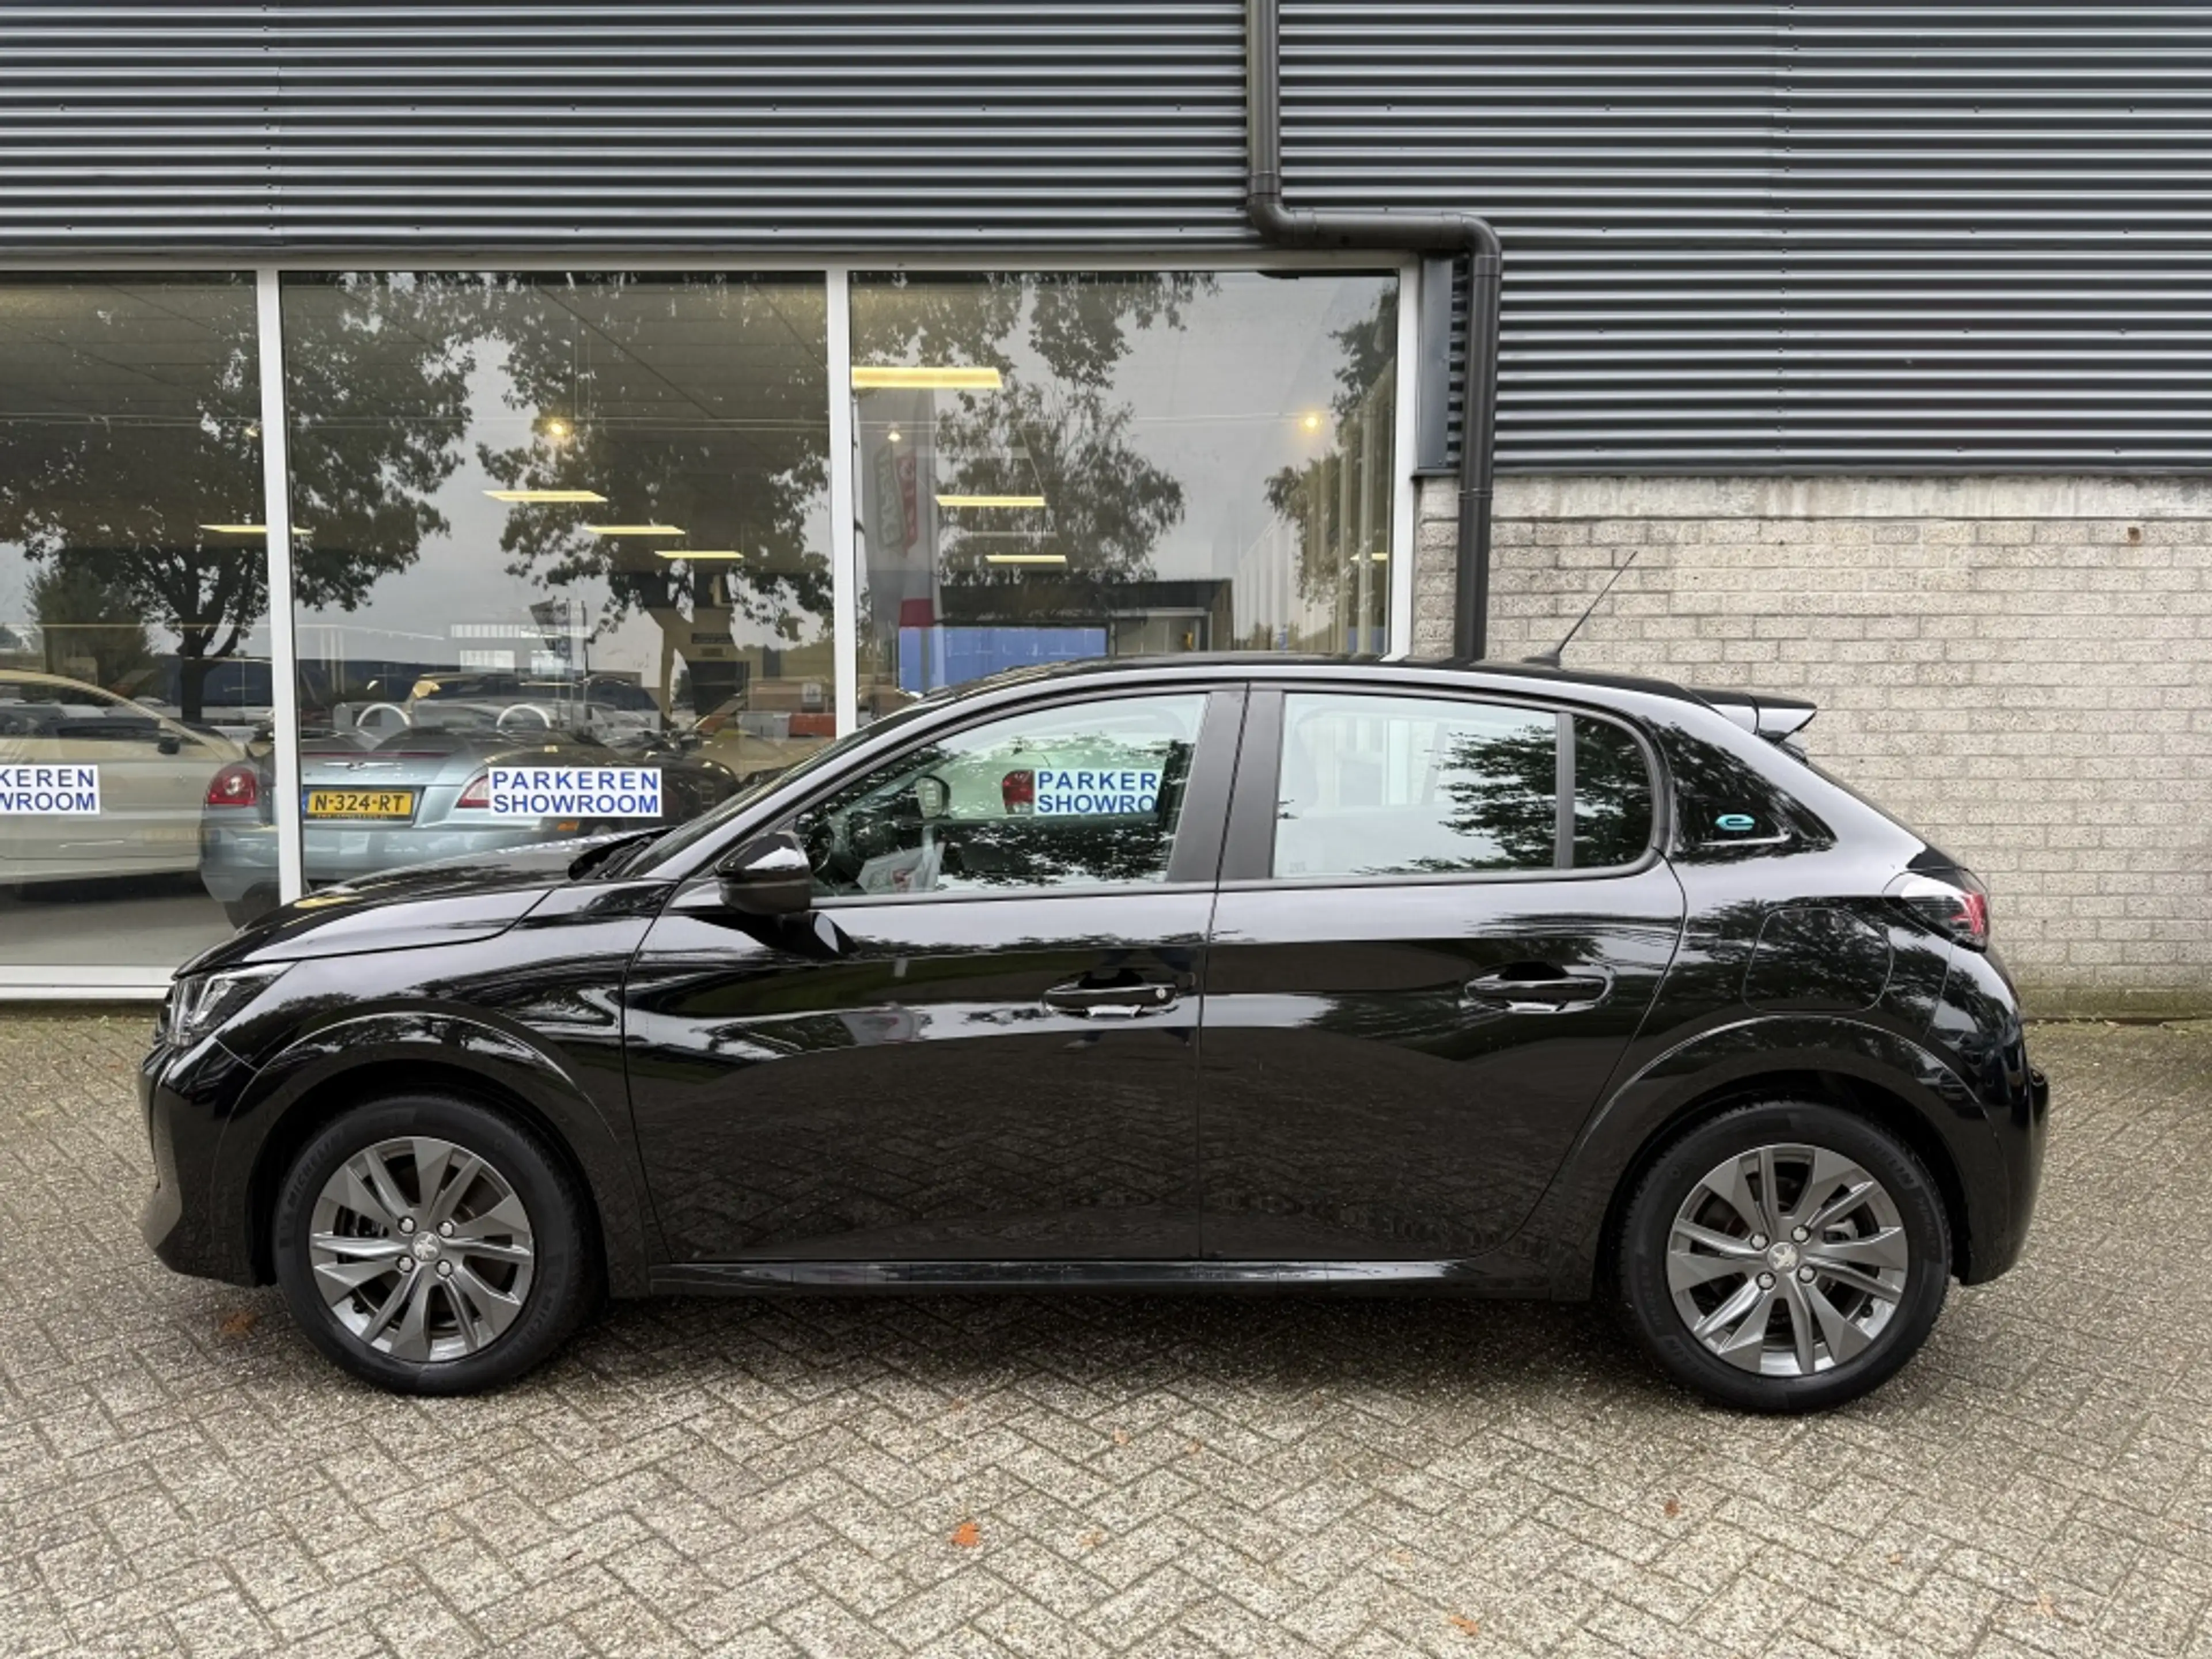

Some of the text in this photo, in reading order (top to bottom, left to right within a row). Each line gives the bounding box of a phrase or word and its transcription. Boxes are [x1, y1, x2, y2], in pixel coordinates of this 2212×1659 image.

[493, 771, 658, 790] PARKEREN
[1039, 771, 1157, 790] PARKER
[315, 794, 405, 812] N-324-RT
[493, 794, 658, 813] SHOWROOM
